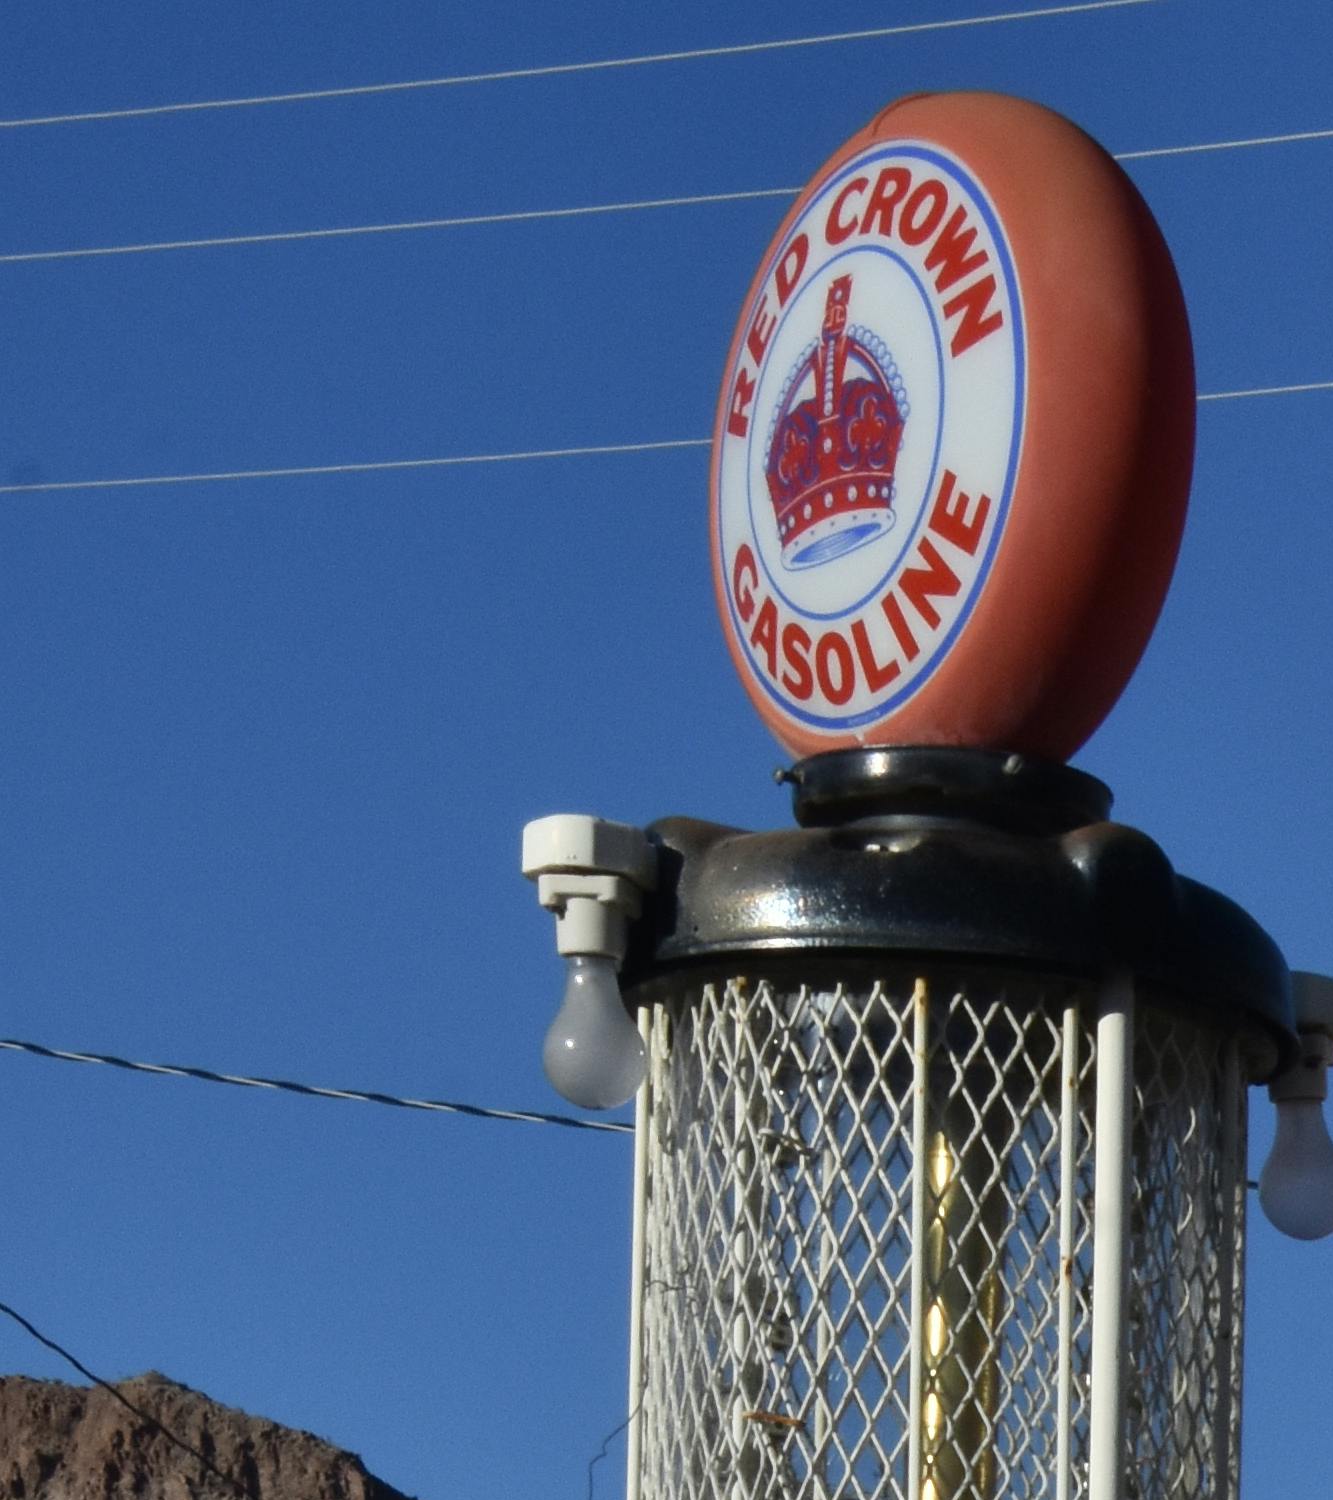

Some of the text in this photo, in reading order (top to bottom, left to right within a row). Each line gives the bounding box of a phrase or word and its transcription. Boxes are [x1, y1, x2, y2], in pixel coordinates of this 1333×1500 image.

[726, 166, 1003, 437] RED CROWN
[733, 469, 991, 706] GASOLINE
